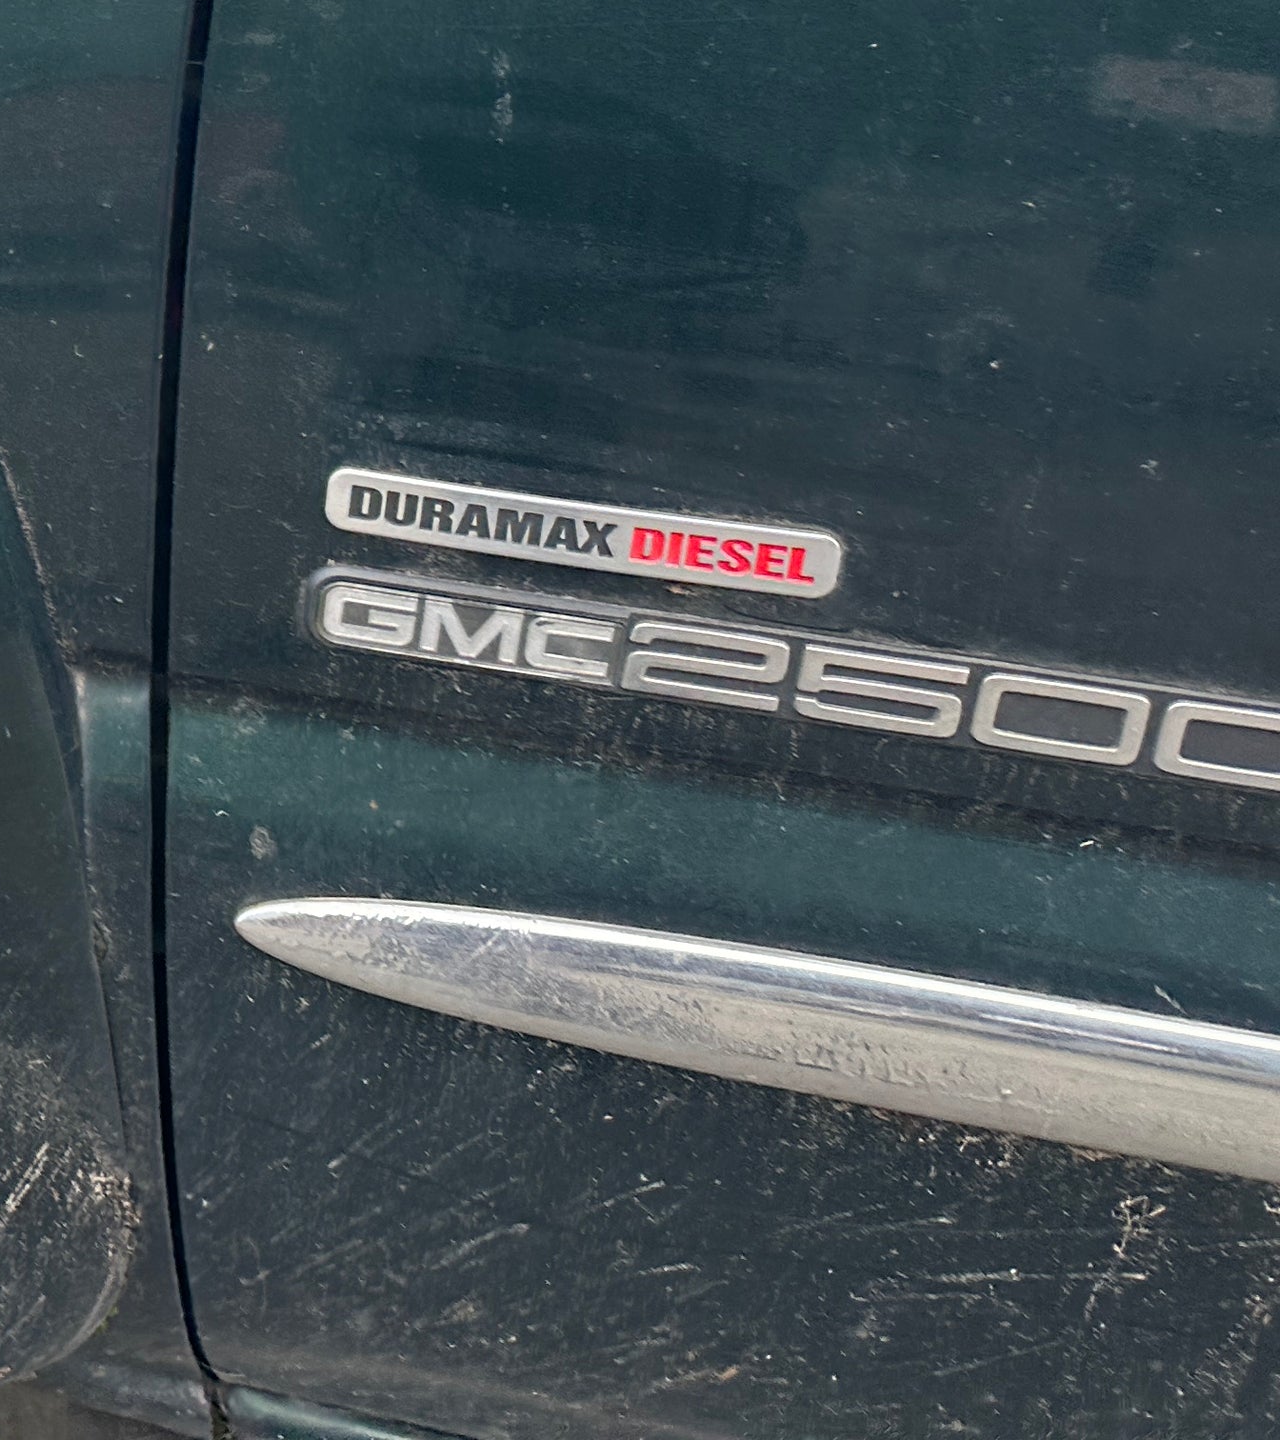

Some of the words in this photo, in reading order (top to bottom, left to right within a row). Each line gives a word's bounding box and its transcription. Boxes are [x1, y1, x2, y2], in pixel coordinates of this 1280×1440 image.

[347, 484, 618, 558] DURAMAX
[628, 526, 815, 586] DIESEL
[322, 581, 616, 684] GMC
